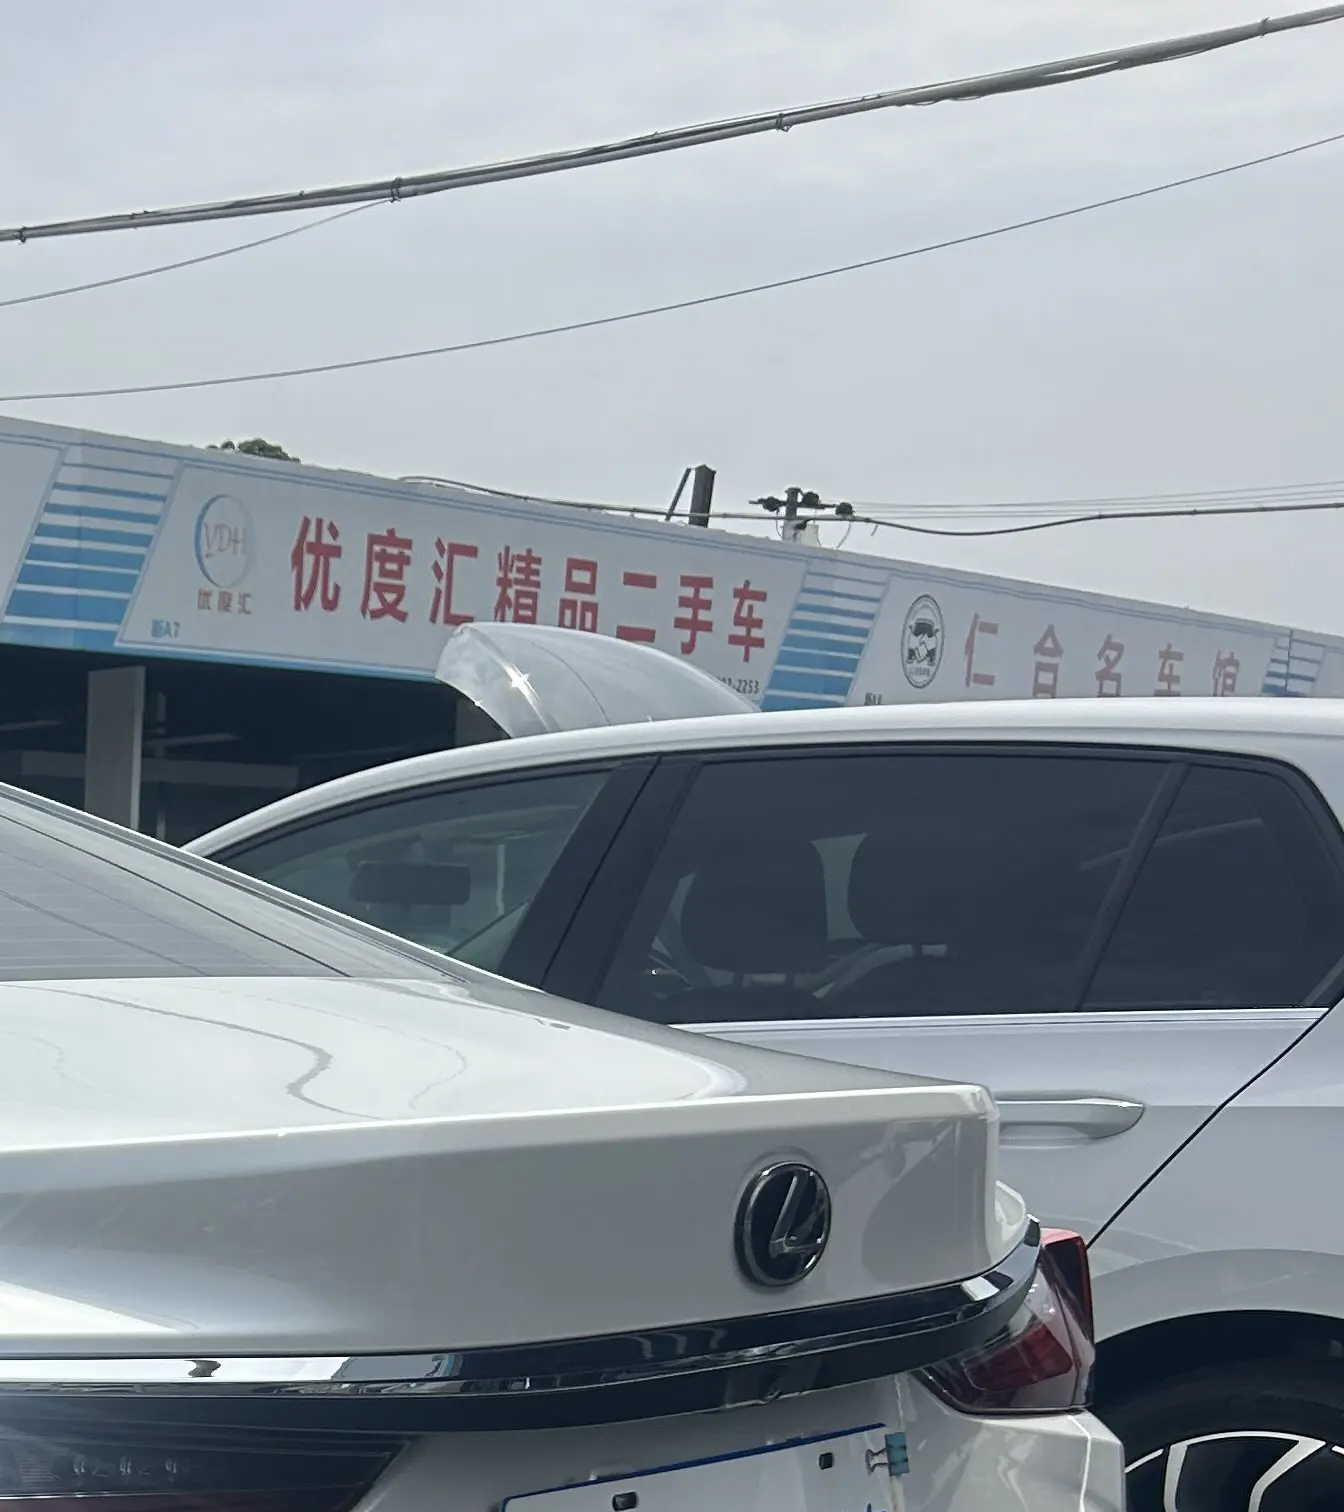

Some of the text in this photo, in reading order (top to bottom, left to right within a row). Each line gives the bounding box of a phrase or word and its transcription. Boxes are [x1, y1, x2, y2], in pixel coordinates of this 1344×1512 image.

[289, 515, 768, 663] 优度汇精品二手车
